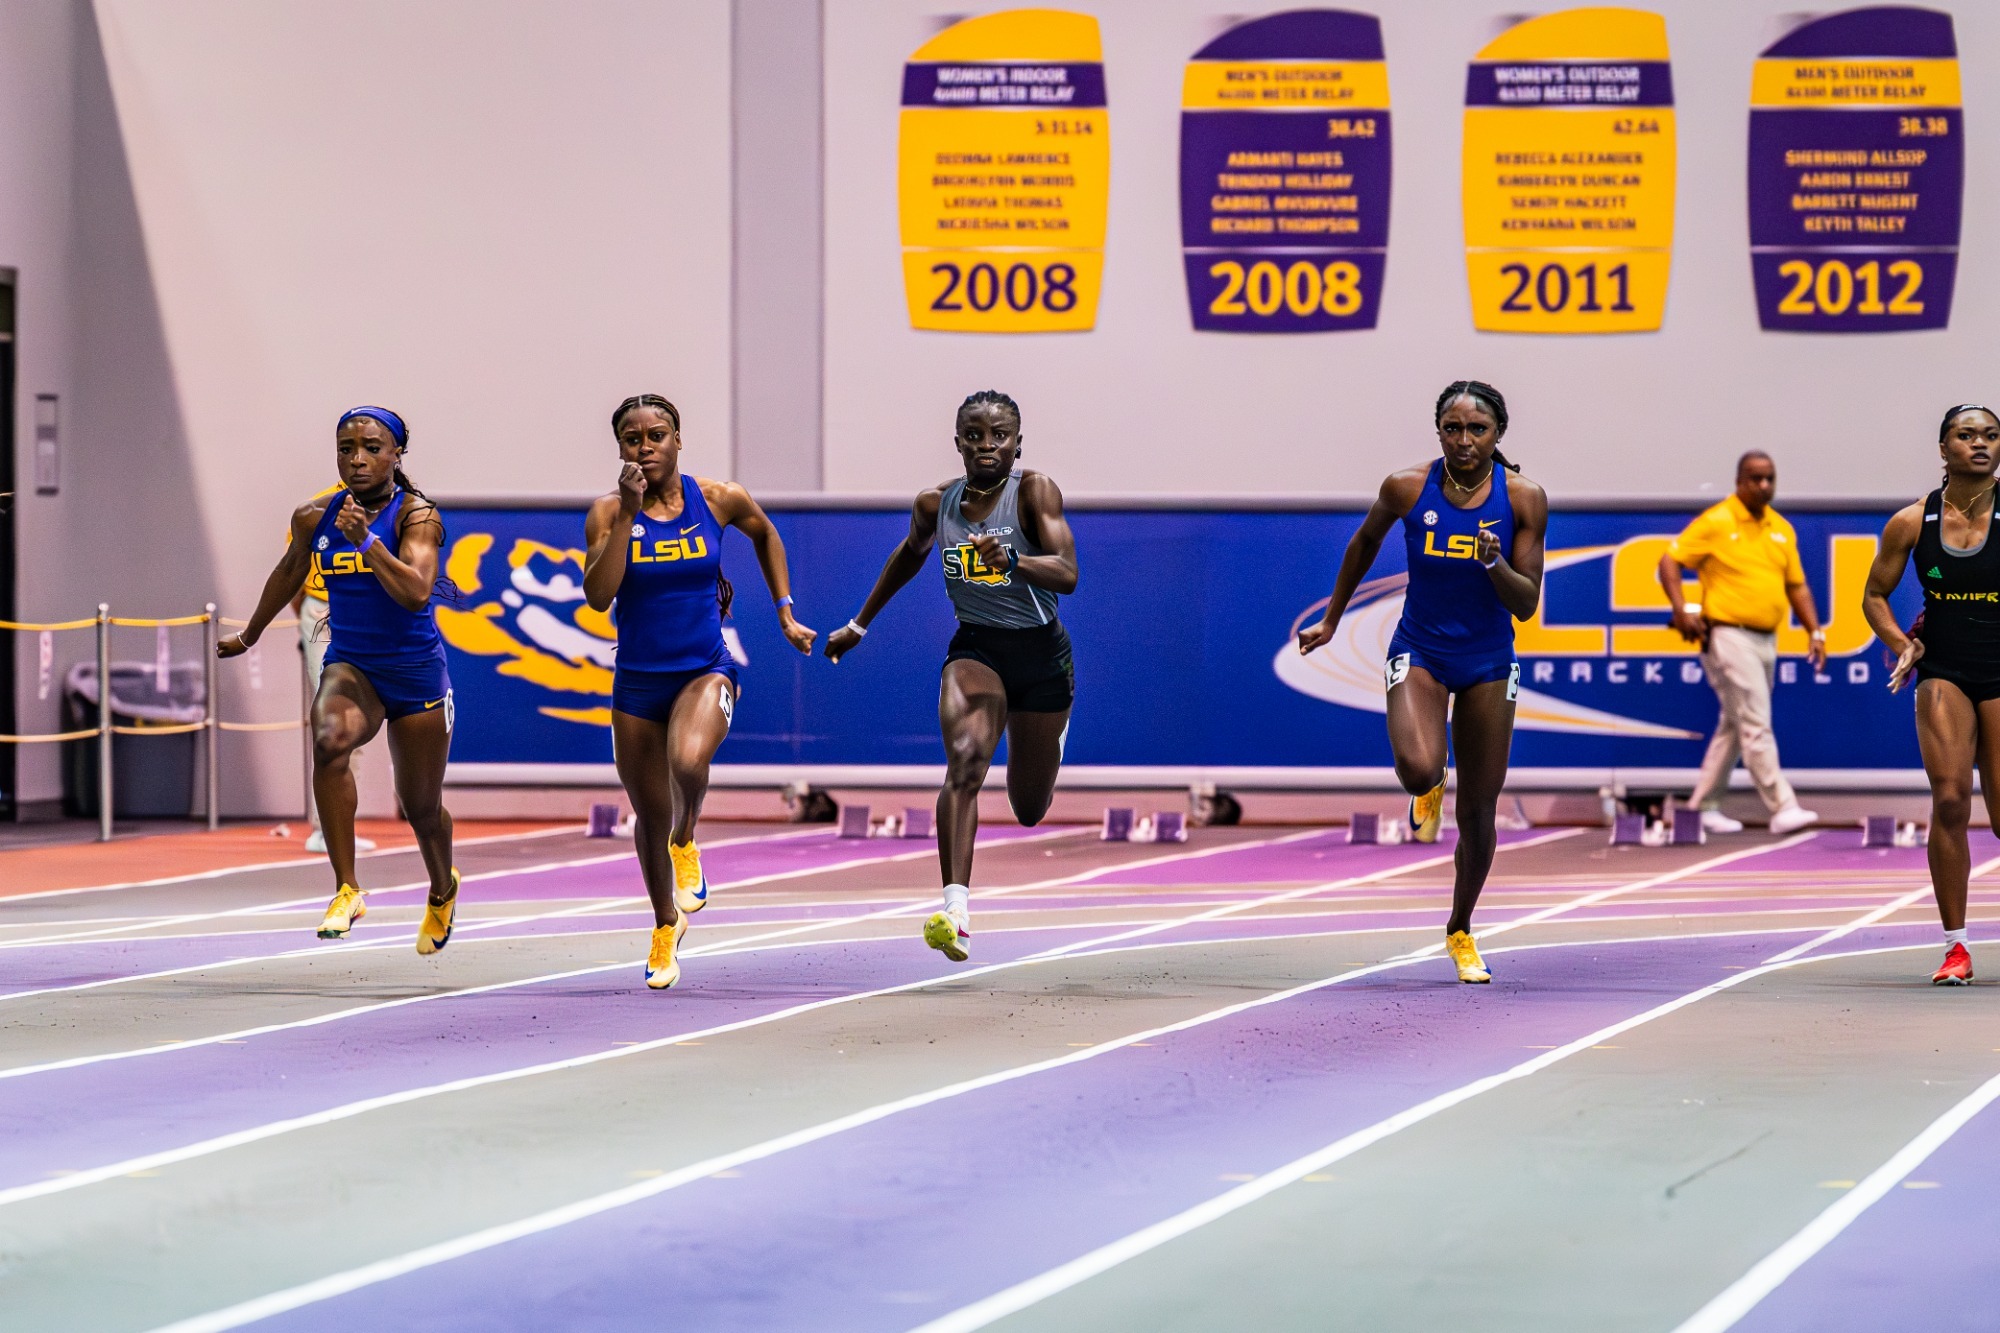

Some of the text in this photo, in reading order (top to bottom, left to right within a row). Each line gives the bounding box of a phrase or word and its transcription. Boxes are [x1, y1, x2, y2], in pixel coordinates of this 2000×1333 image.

[1495, 66, 1640, 84] WOMEN'S OUTDOOR
[1795, 67, 1915, 80] MEN'S OUTDOOR
[979, 85, 1028, 102] METER
[1543, 84, 1593, 102] METER
[1595, 84, 1640, 102] RELAY
[1831, 85, 1879, 98] METER
[1883, 85, 1926, 98] RELAY
[1581, 218, 1637, 231] WILSON
[931, 262, 1078, 314] 2008
[1209, 260, 1363, 316] 2008
[1500, 262, 1636, 314] 2011
[1778, 259, 1925, 315] 2012
[631, 535, 708, 563] LSU
[1423, 531, 1480, 560] LS
